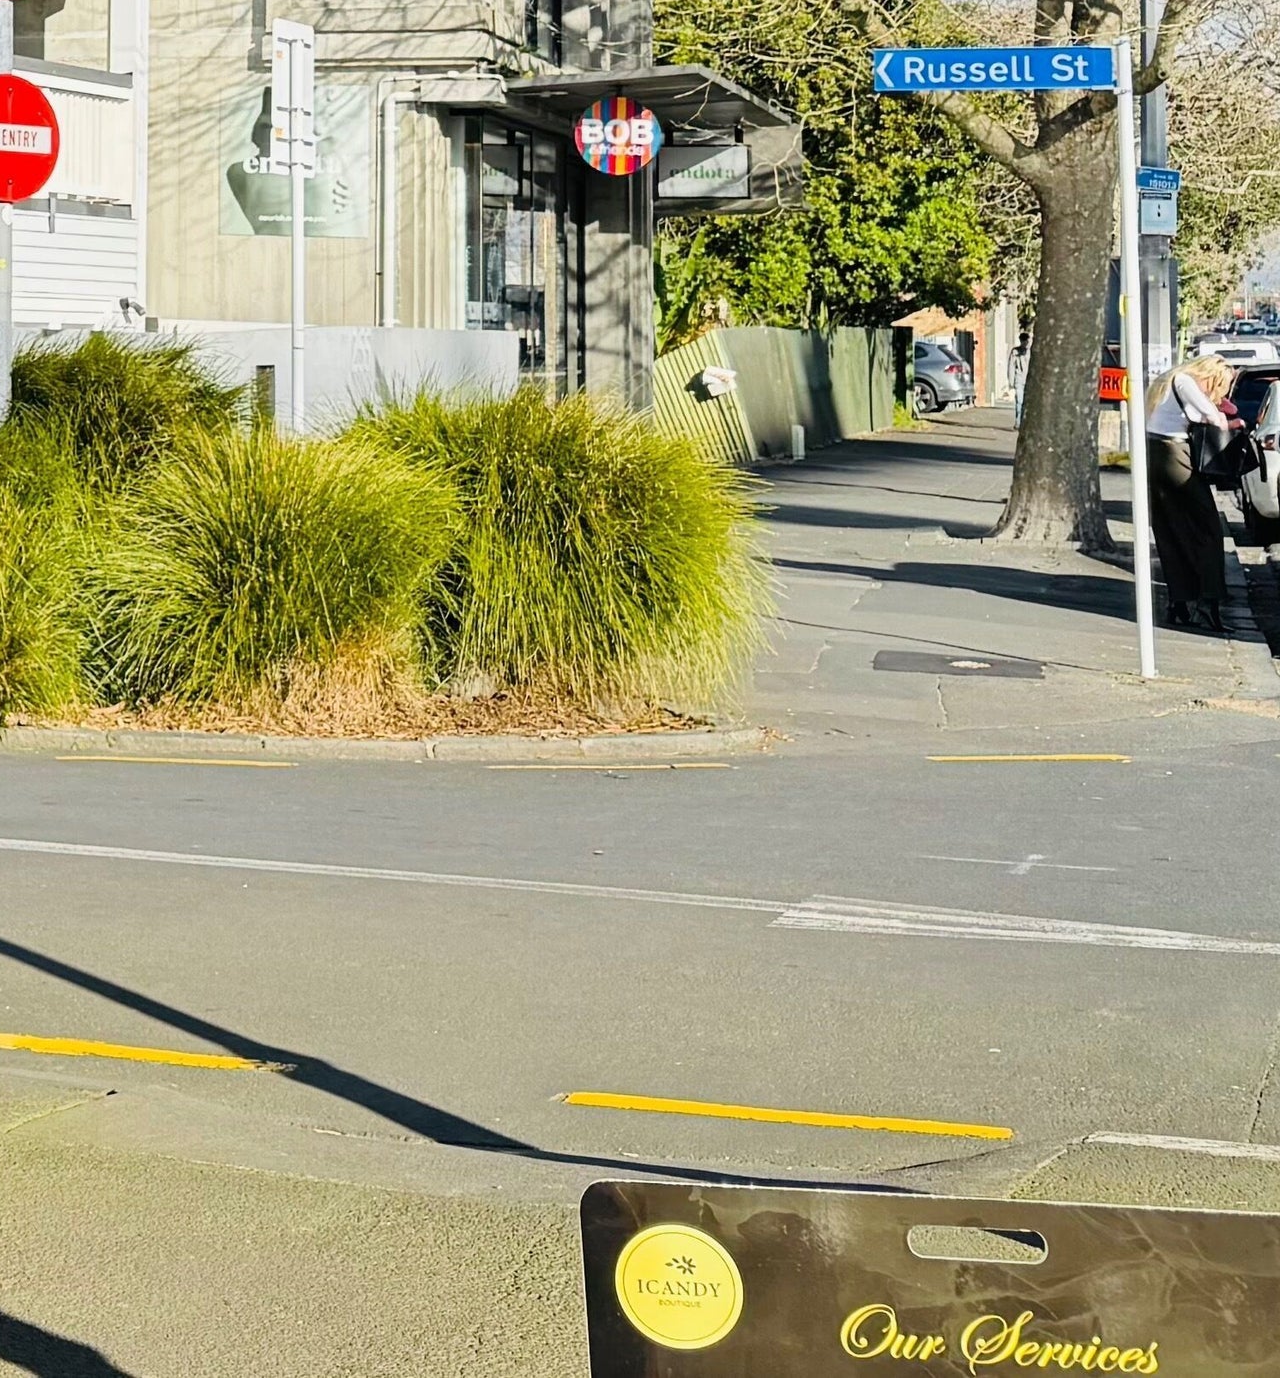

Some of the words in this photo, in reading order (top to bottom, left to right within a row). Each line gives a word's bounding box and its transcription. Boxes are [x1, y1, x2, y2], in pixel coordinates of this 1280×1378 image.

[904, 55, 1035, 84] Russell
[1051, 53, 1090, 83] St
[2, 128, 38, 148] ENTRY
[581, 118, 655, 145] BOB
[637, 1279, 721, 1298] ICANDY
[658, 1299, 702, 1309] BOUTIQUE
[840, 1303, 946, 1360] Our
[961, 1310, 1159, 1376] Services
